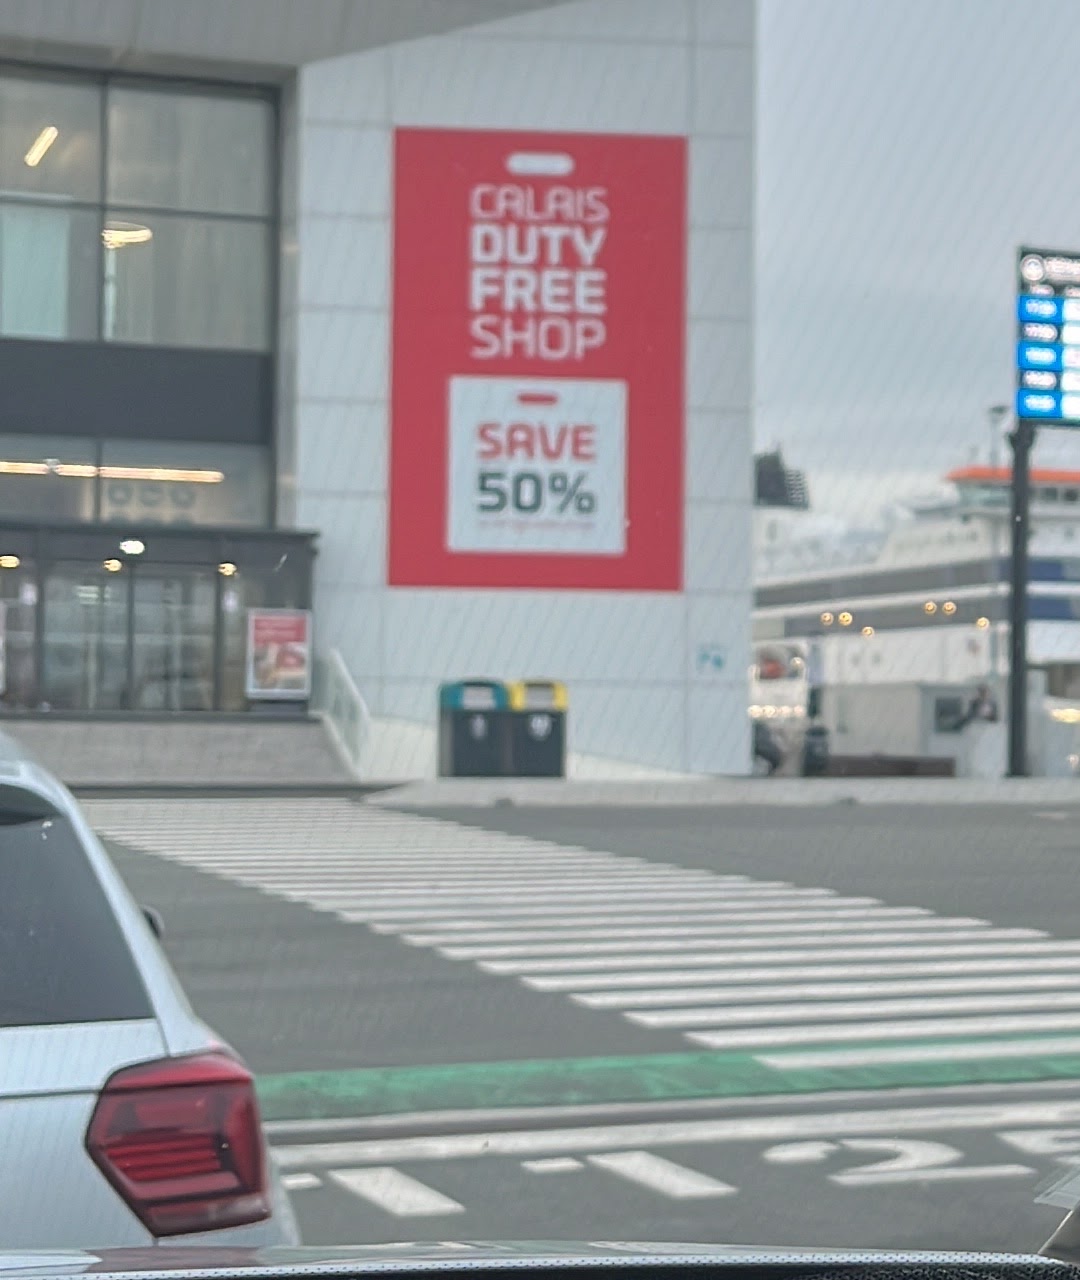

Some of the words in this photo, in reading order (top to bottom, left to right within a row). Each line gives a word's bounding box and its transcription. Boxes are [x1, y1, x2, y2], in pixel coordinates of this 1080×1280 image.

[470, 184, 609, 222] CALAIS
[470, 224, 607, 265] DUTY
[470, 268, 607, 314] FREE
[470, 315, 607, 360] SHOP
[477, 423, 597, 461] SAVE
[477, 471, 597, 514] 50%
